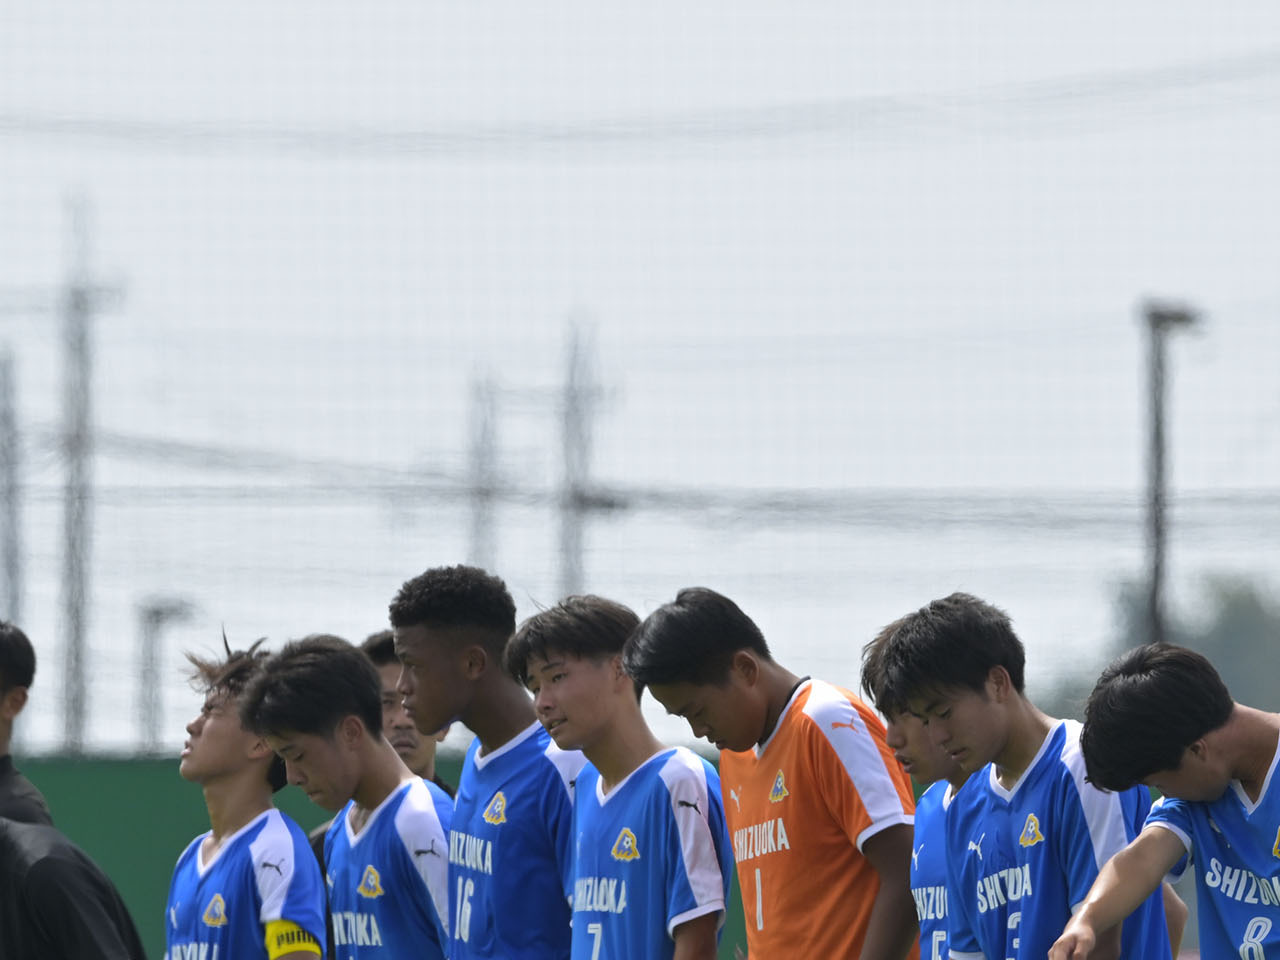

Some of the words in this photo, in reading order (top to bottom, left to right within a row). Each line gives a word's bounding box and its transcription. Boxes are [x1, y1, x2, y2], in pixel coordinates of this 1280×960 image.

[734, 817, 790, 864] SHIZUOKA
[454, 875, 475, 943] 16
[755, 868, 764, 931] 1
